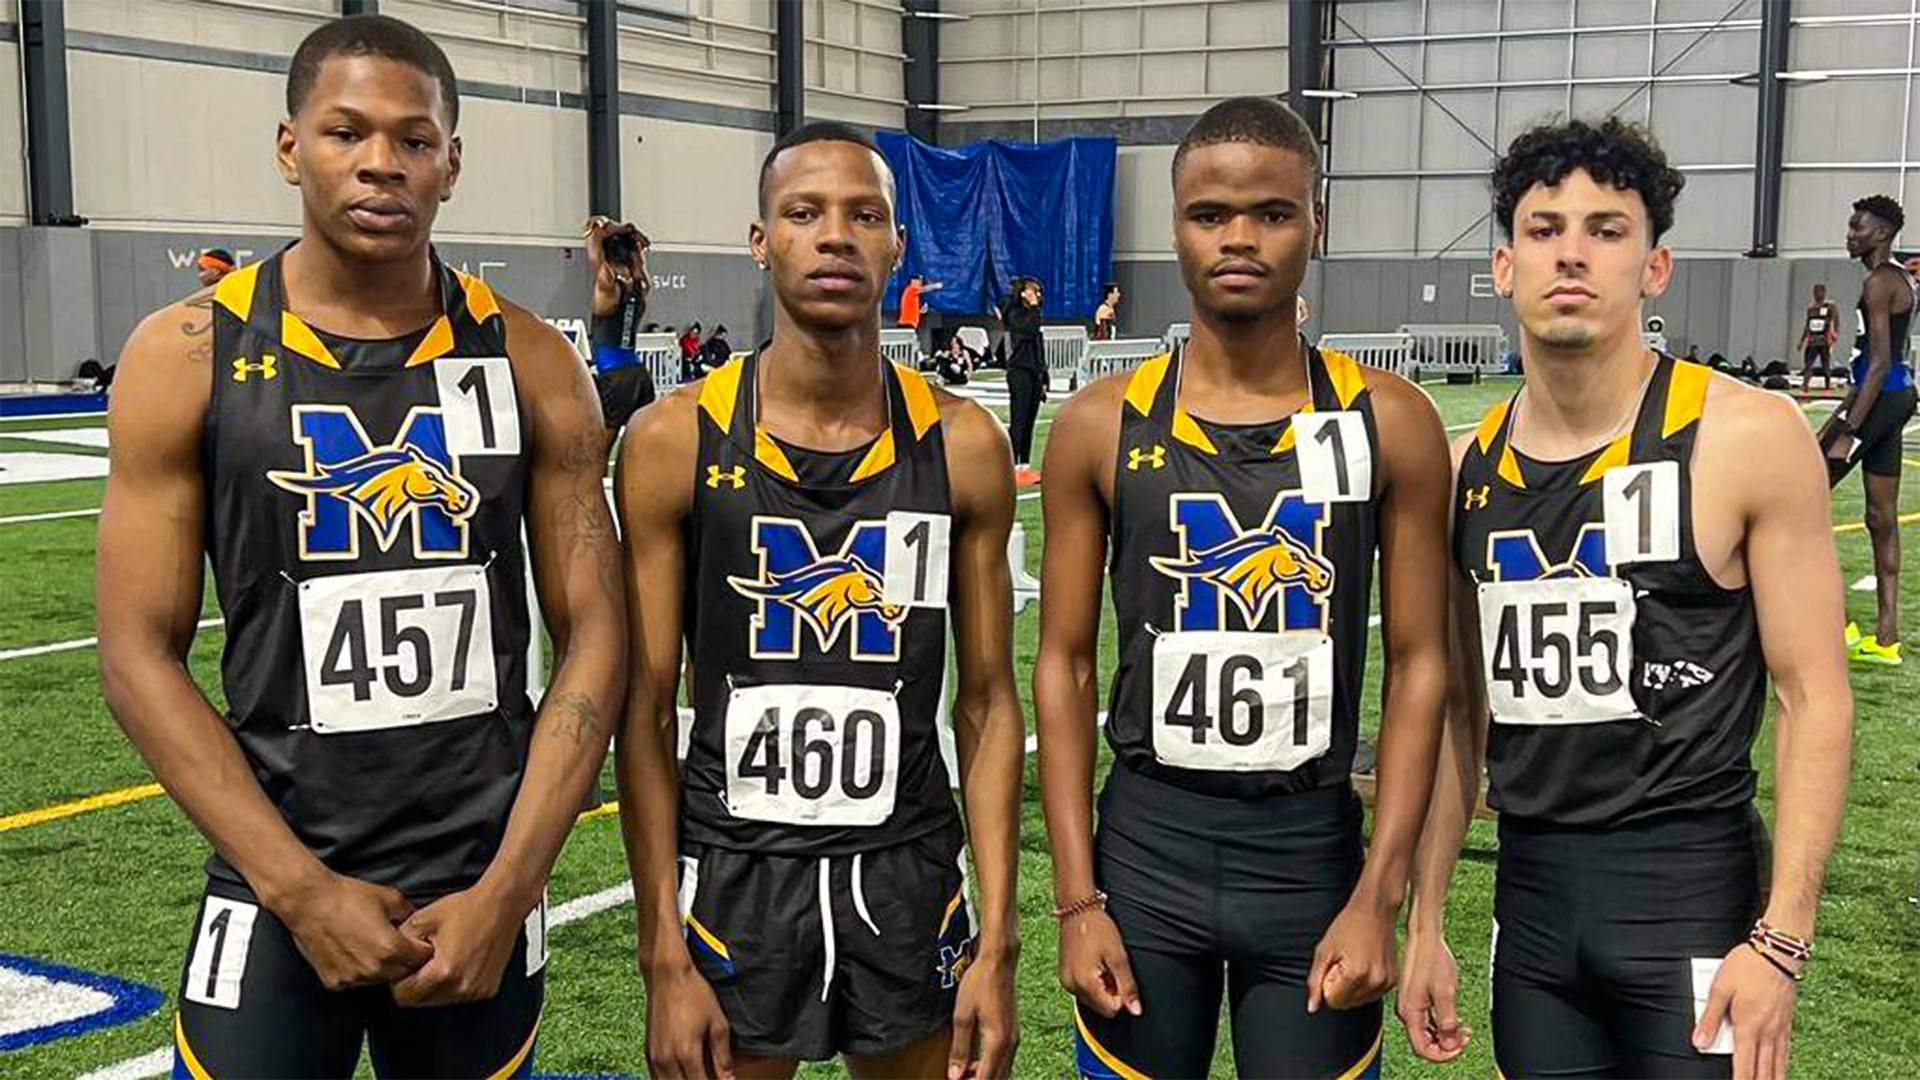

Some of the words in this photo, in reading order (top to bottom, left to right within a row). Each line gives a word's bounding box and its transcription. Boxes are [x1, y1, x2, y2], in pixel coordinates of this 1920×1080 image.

[458, 365, 497, 449] 1
[291, 404, 470, 559] M
[1314, 418, 1351, 496] 1
[1622, 469, 1652, 555] 1
[750, 515, 901, 662] M
[902, 520, 931, 601] 1
[1170, 488, 1332, 632] M
[320, 589, 477, 702] 457
[1493, 600, 1623, 699] 455
[1164, 653, 1310, 746] 461
[737, 706, 886, 800] 460
[205, 908, 232, 998] 1
